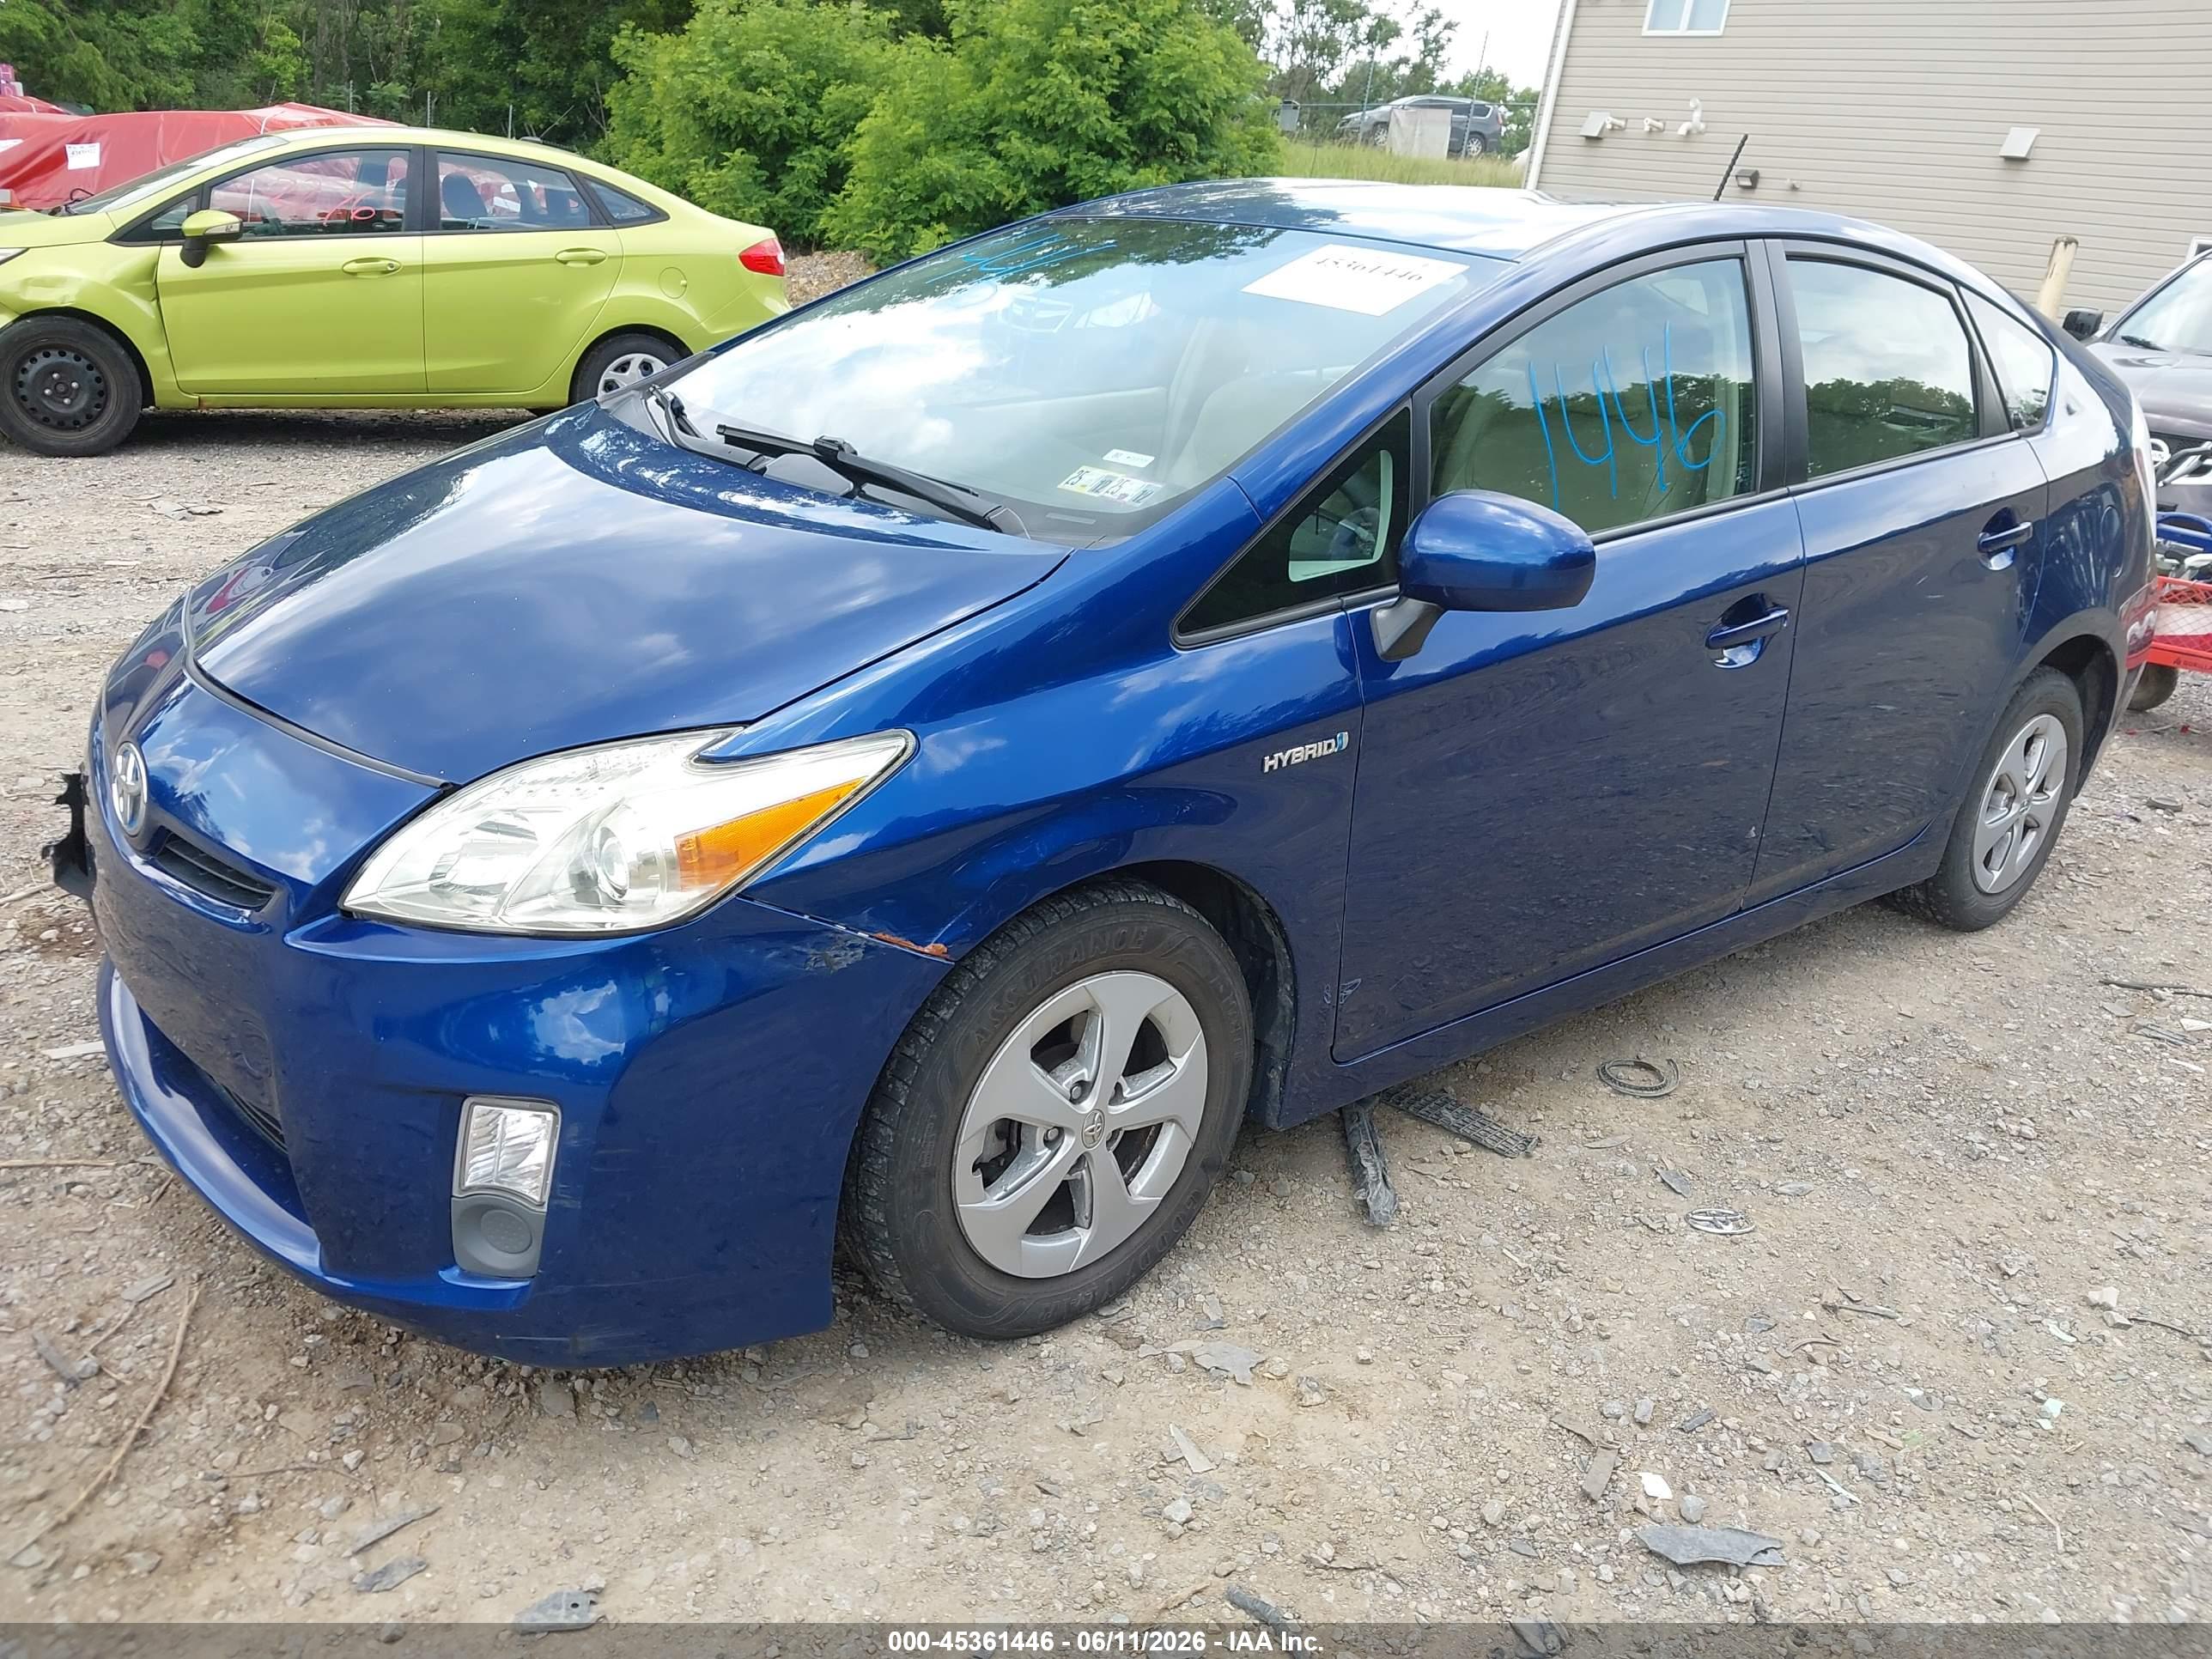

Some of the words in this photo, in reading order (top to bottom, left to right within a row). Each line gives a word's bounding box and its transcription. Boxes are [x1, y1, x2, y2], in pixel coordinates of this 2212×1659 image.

[1528, 319, 1727, 513] 1446
[1263, 738, 1336, 774] HYBRID
[974, 926, 1149, 1049] ASSURANCE
